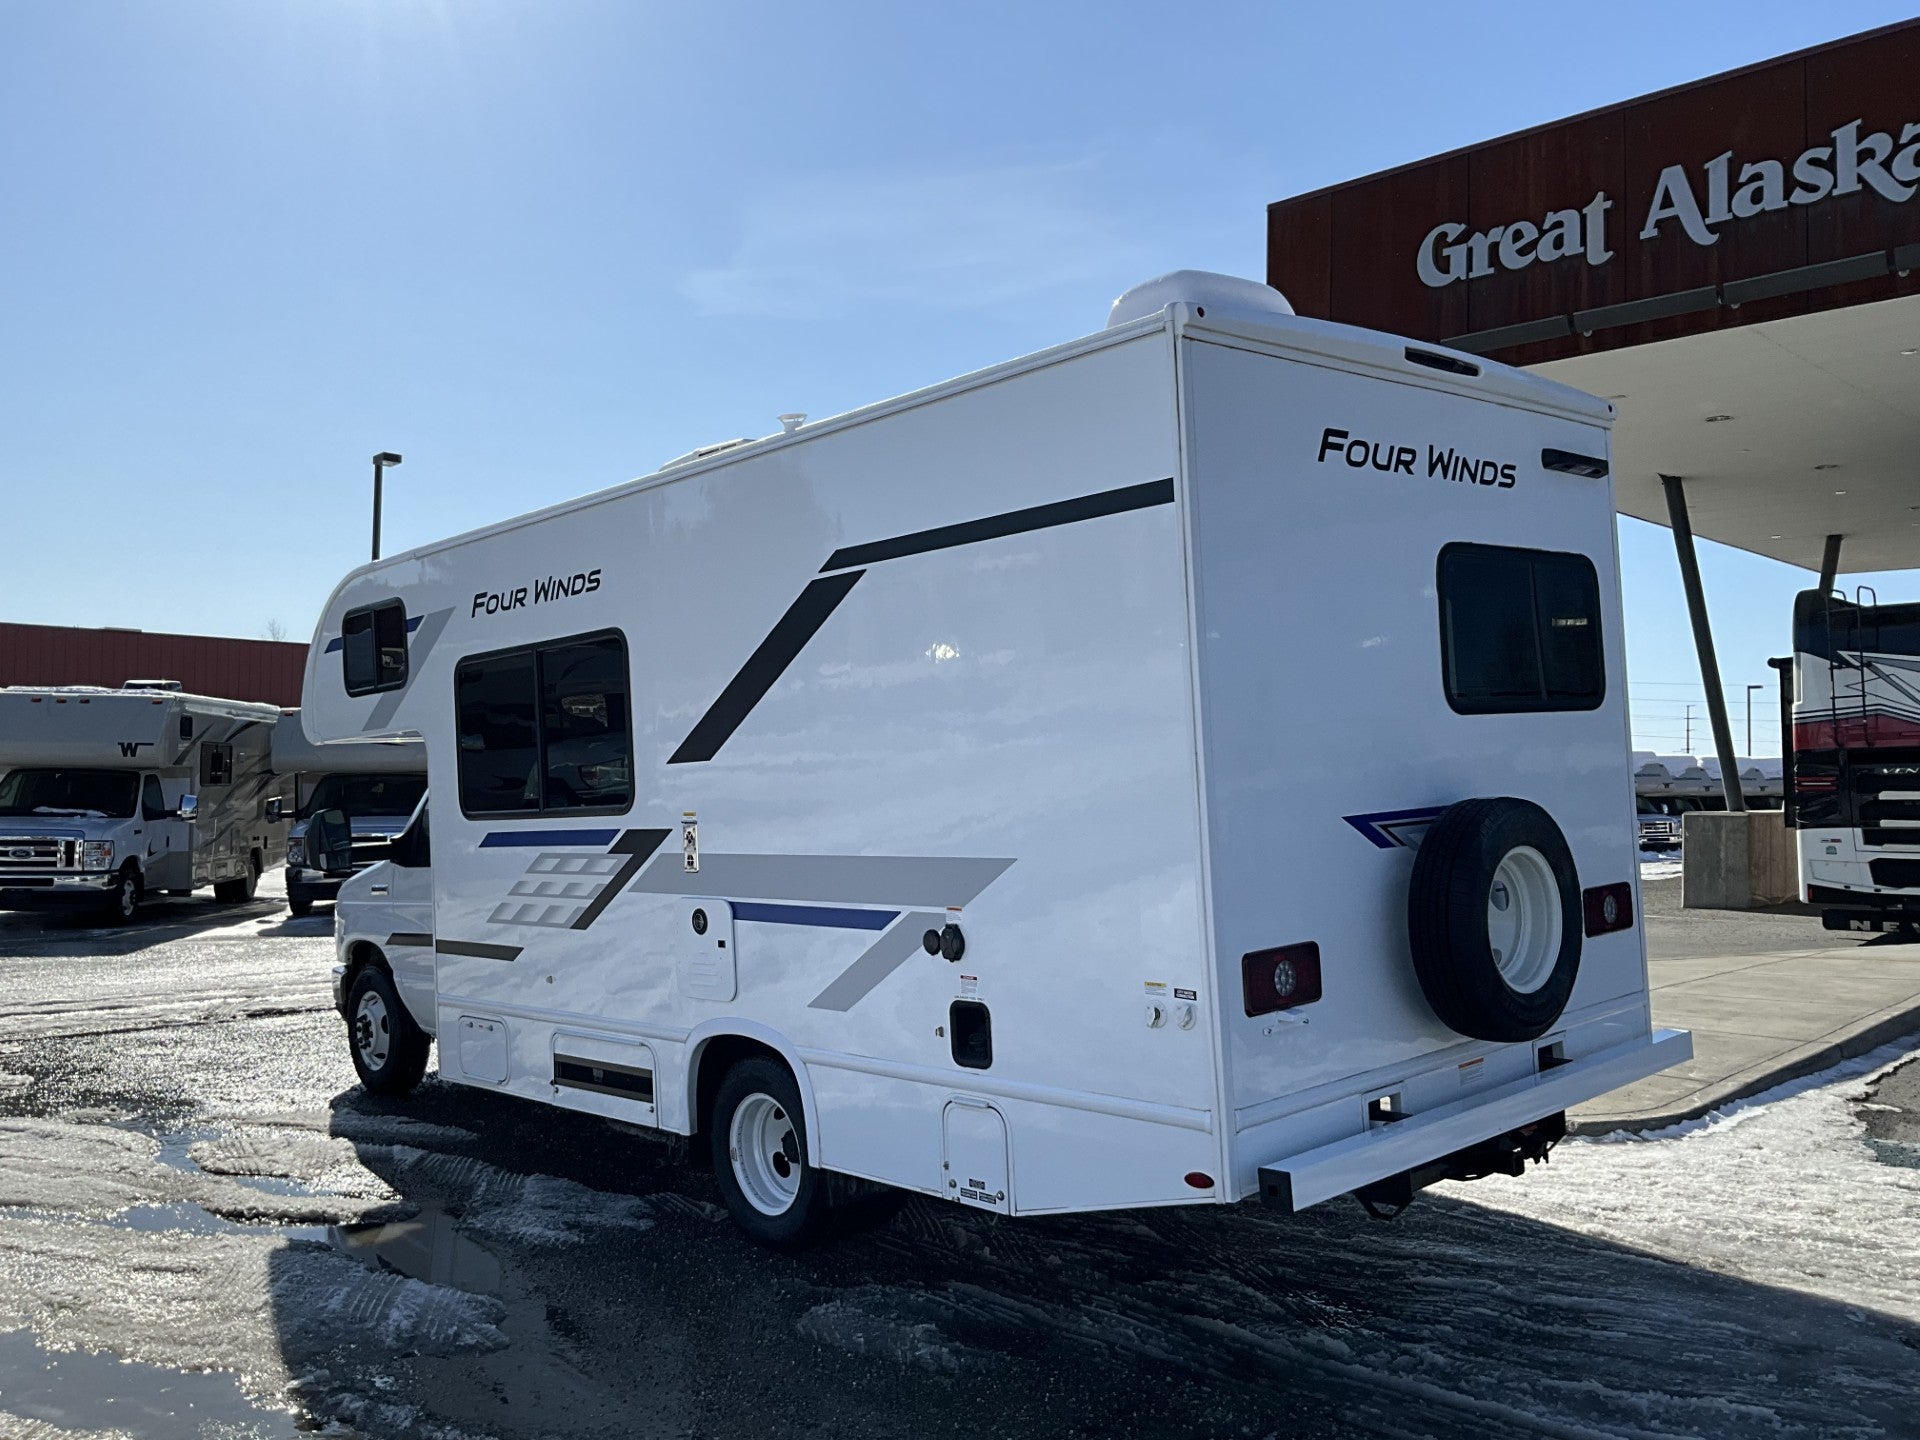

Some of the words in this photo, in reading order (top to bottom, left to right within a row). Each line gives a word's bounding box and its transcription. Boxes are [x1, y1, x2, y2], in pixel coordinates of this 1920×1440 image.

[1416, 191, 1614, 288] Great
[1318, 427, 1417, 475] FOUR
[1428, 444, 1517, 489] WINDS
[471, 587, 528, 618] FOUR
[534, 568, 602, 605] WINDS
